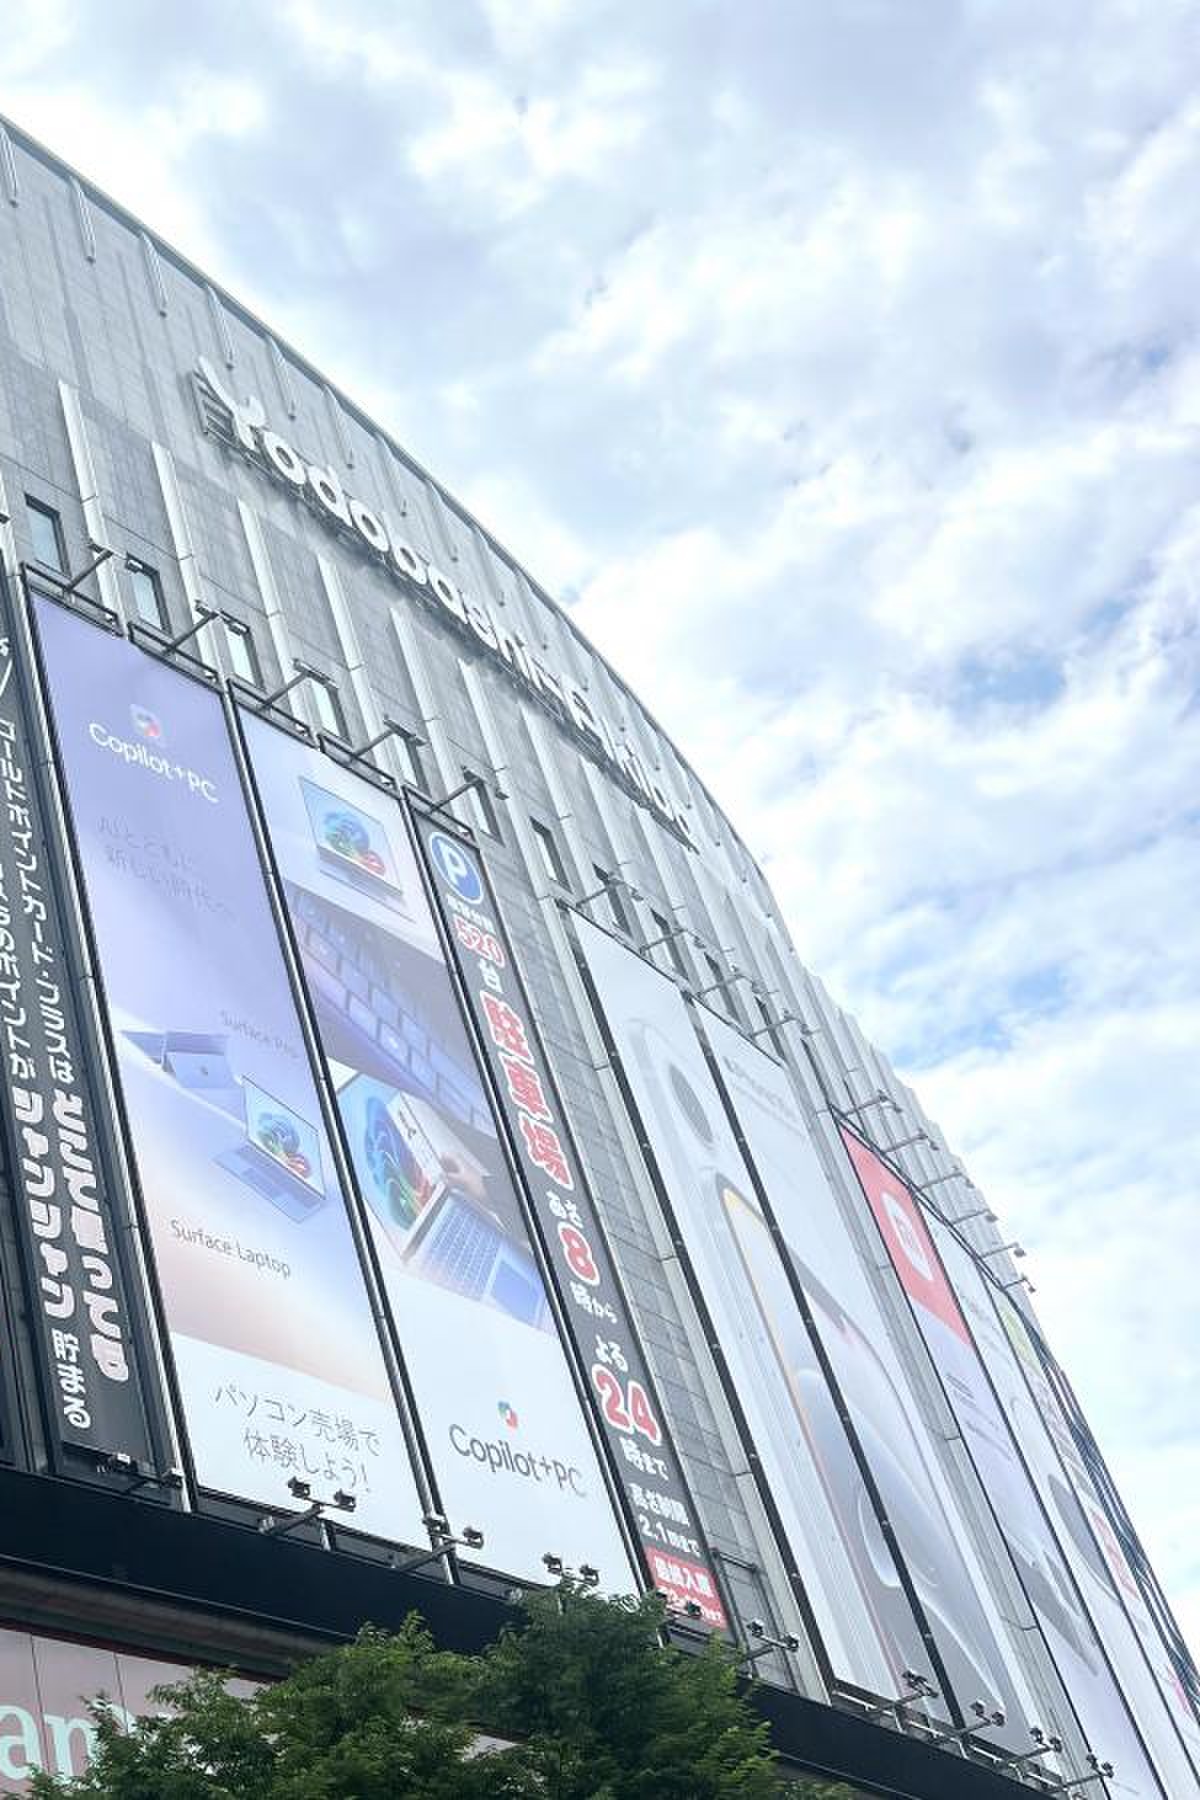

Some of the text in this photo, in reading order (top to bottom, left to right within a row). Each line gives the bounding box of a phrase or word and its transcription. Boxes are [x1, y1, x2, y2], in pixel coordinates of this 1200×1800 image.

[171, 1219, 292, 1279] Surface Laptop
[557, 1221, 599, 1287] 8
[596, 1334, 628, 1373] よる
[591, 1363, 661, 1446] 24
